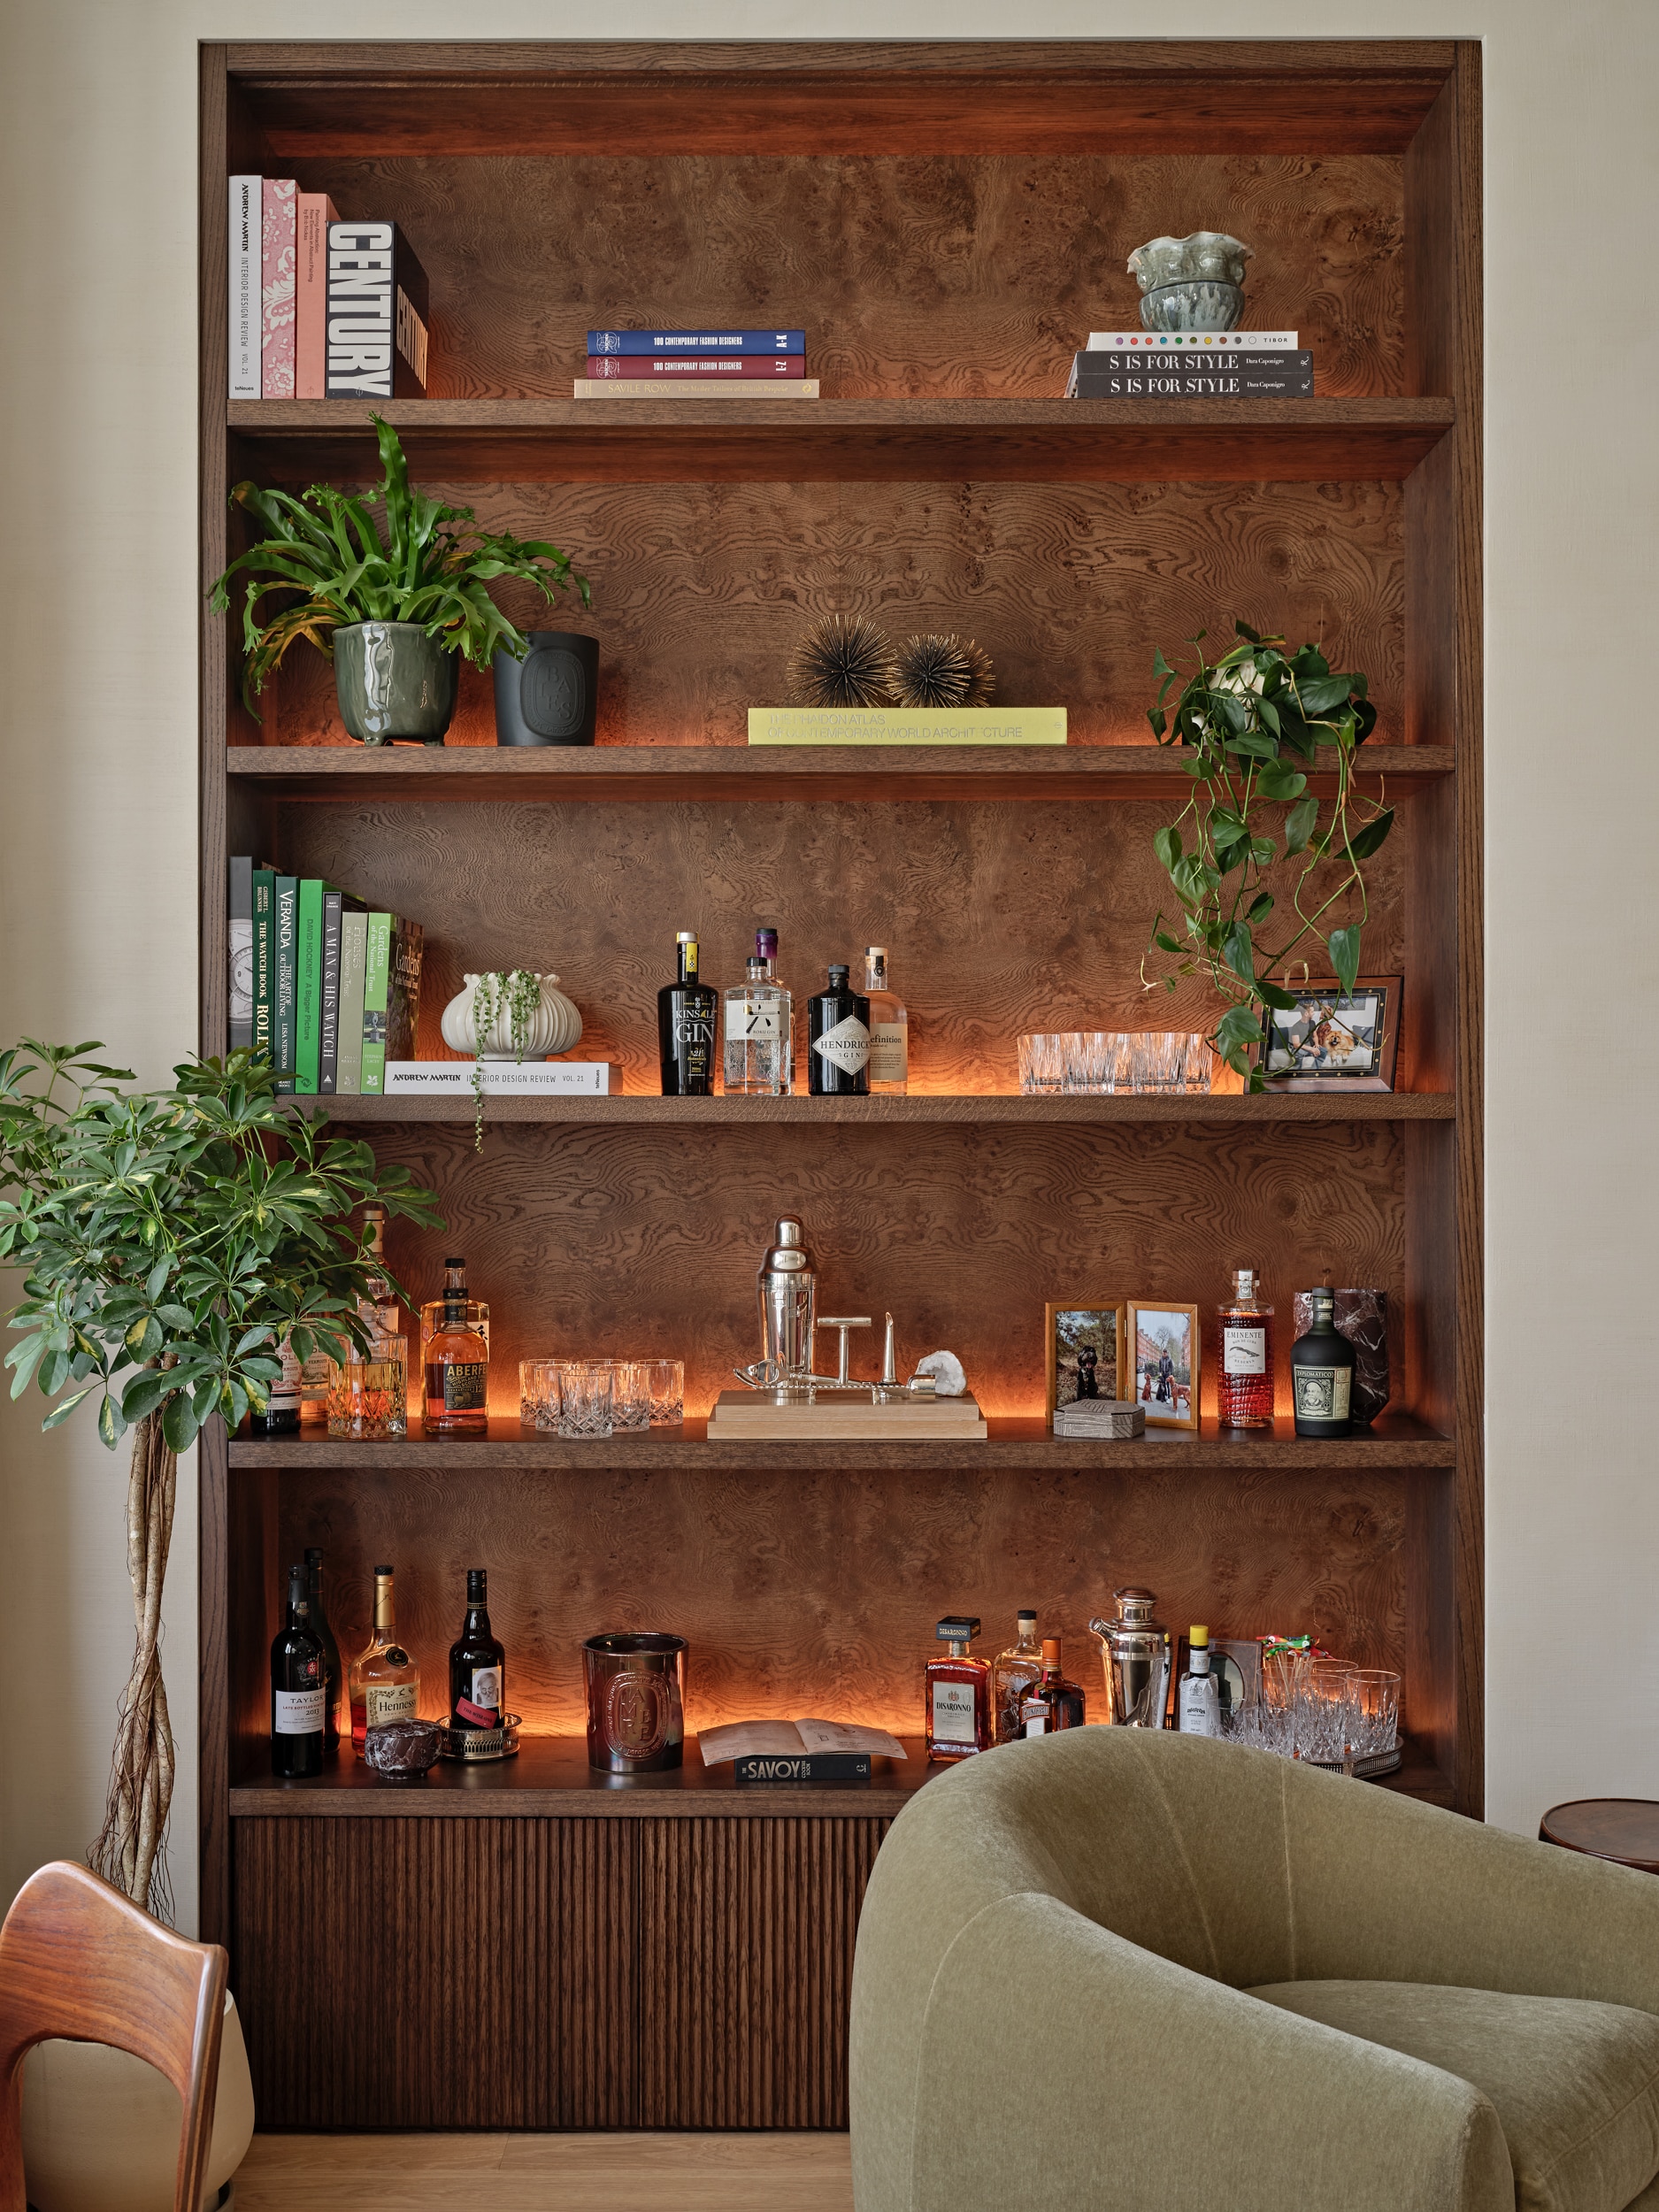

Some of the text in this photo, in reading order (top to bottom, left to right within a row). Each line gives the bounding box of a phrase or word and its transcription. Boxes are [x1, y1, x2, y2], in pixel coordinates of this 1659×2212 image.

[328, 224, 392, 396] CENTURY
[240, 320, 249, 347] REVIEW
[654, 337, 743, 346] 100 CONTEMPORARY FASHION DESIGNERS
[664, 362, 698, 371] CONTEMPORARY
[699, 362, 718, 371] FASHION
[718, 362, 742, 371] DESIGNERS
[1110, 355, 1239, 370] S IS FOR STYLE
[608, 384, 672, 393] SAVILE ROW
[1110, 378, 1240, 393] S IS FOR STYLE
[849, 714, 886, 725] ATLAS
[887, 727, 931, 738] WORLD
[933, 727, 1023, 738] ARCHITCTURE
[279, 890, 294, 949] VERANDA
[353, 926, 365, 969] Houses
[377, 926, 388, 967] Gardens
[304, 941, 313, 979] HOCKNEY
[396, 942, 419, 976] Gardens
[323, 924, 337, 1058] A MAN & HIS WATCH
[285, 993, 291, 1006] OF
[675, 1023, 715, 1043] GIN
[870, 1034, 902, 1043] efinition
[936, 1701, 972, 1712] DISARONNO
[748, 1761, 801, 1778] SAVOY
